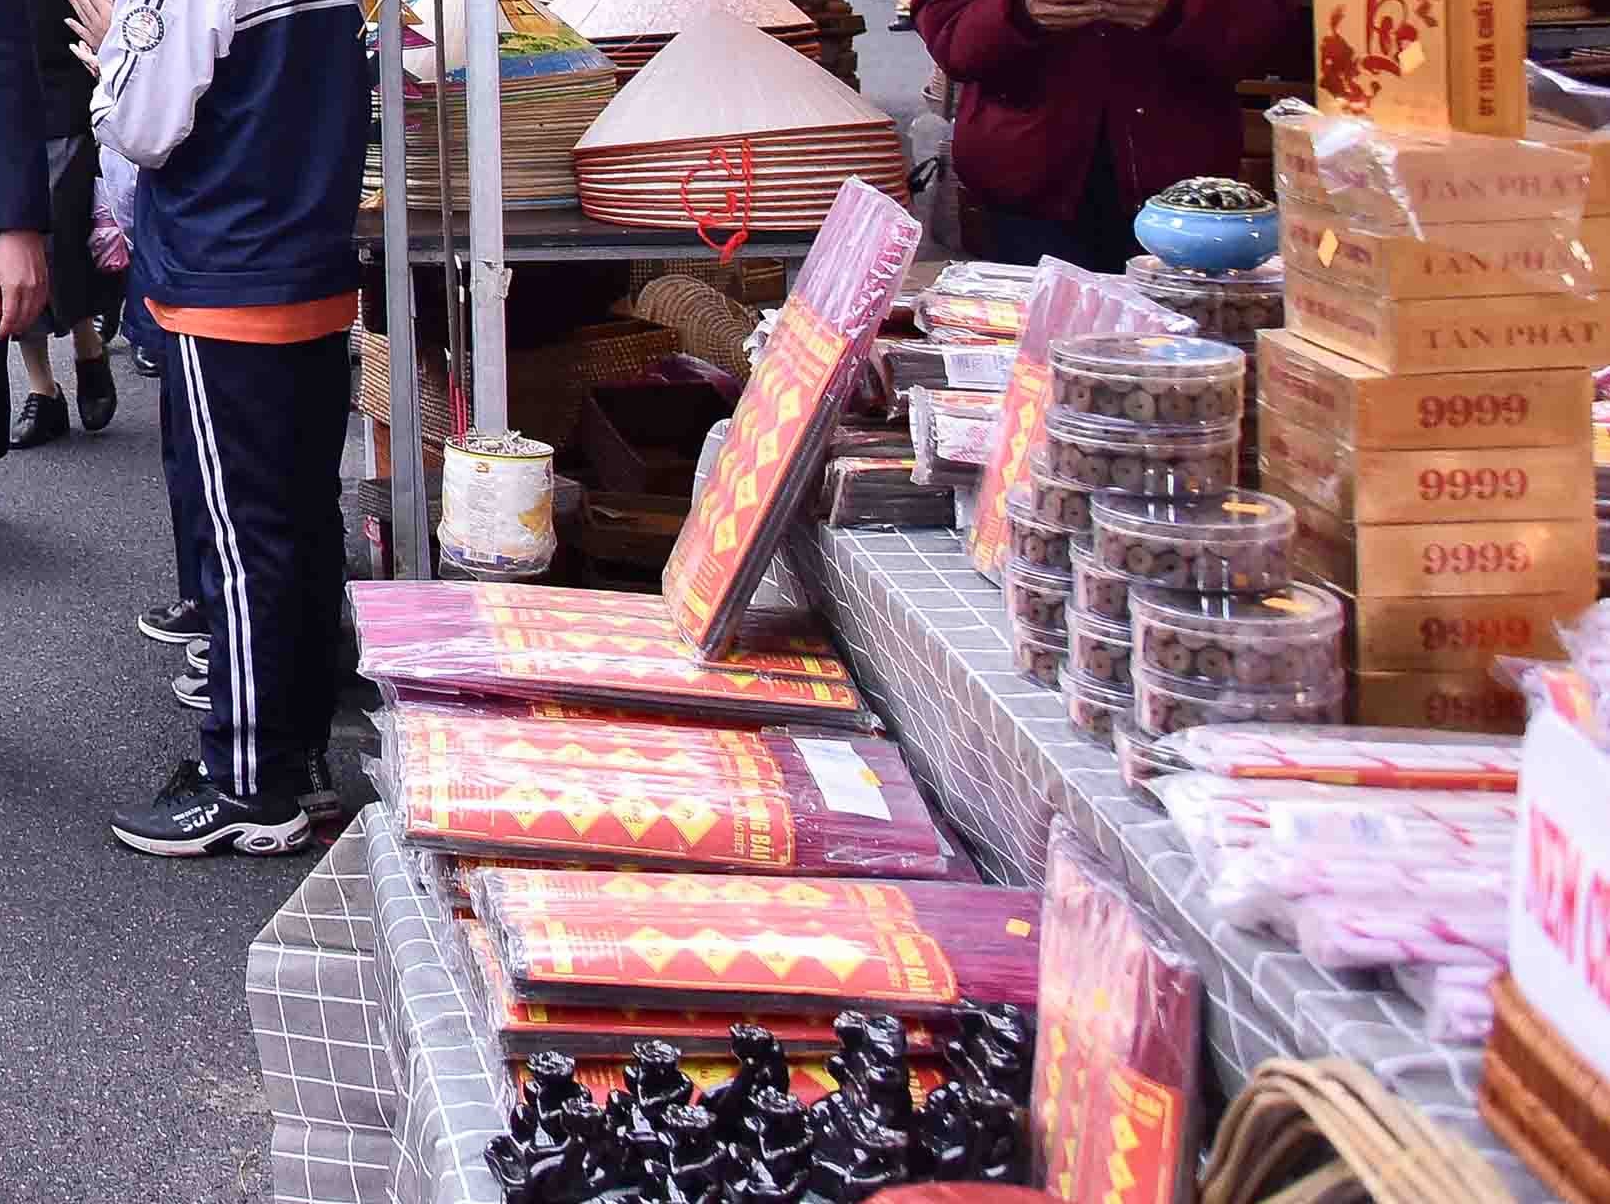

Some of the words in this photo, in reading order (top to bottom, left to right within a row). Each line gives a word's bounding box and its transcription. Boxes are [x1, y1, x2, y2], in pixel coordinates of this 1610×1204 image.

[1418, 393, 1530, 429] 9999
[1418, 467, 1529, 501] 9999
[1421, 541, 1532, 575] 9999
[1419, 616, 1532, 651] 9999
